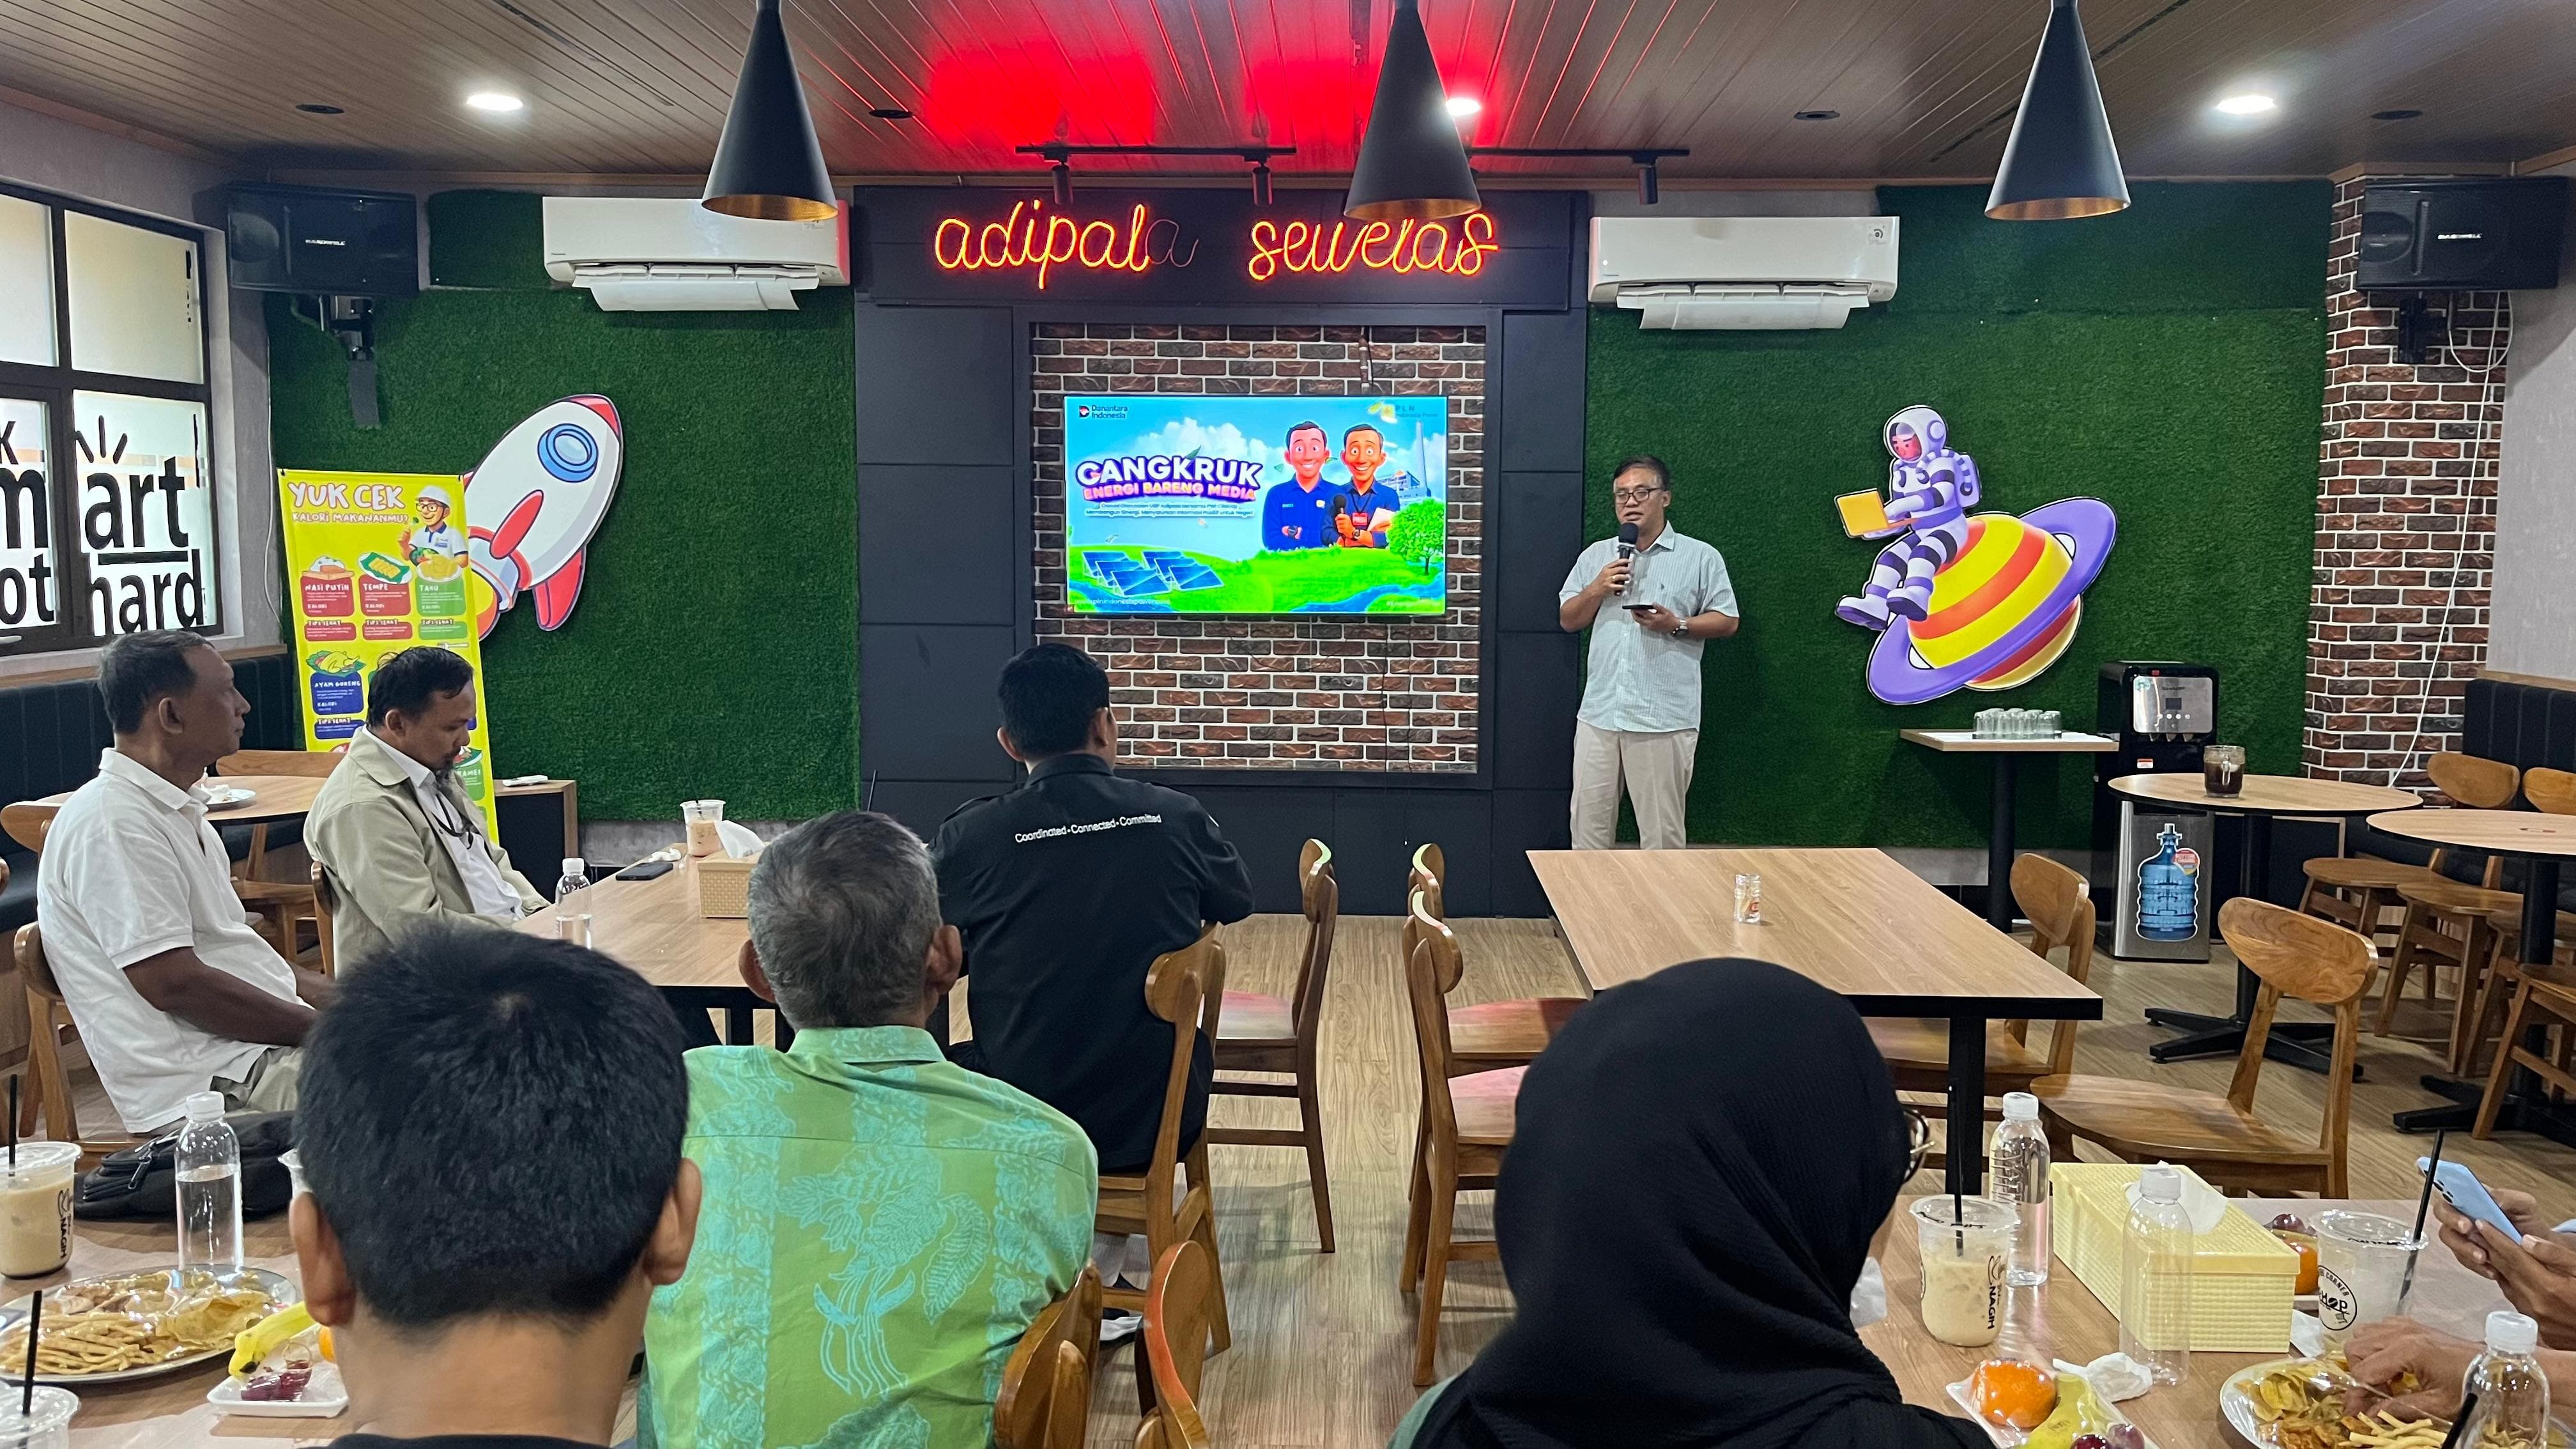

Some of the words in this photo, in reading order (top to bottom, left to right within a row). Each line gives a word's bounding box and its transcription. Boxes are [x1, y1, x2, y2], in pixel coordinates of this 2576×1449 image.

[935, 199, 1199, 289] adipala
[288, 482, 349, 509] YUK
[354, 485, 405, 511] CEK
[1084, 483, 1139, 500] ENERGI
[1143, 481, 1204, 496] BARENG
[1208, 484, 1256, 501] MEDIA
[332, 514, 409, 525] MAKANANMU?
[1015, 825, 1067, 843] Coordinated
[1071, 818, 1116, 834] Connected
[1119, 814, 1162, 826] Committed
[2326, 1271, 2350, 1297] CORNER
[1988, 1285, 1997, 1330] NAGIH
